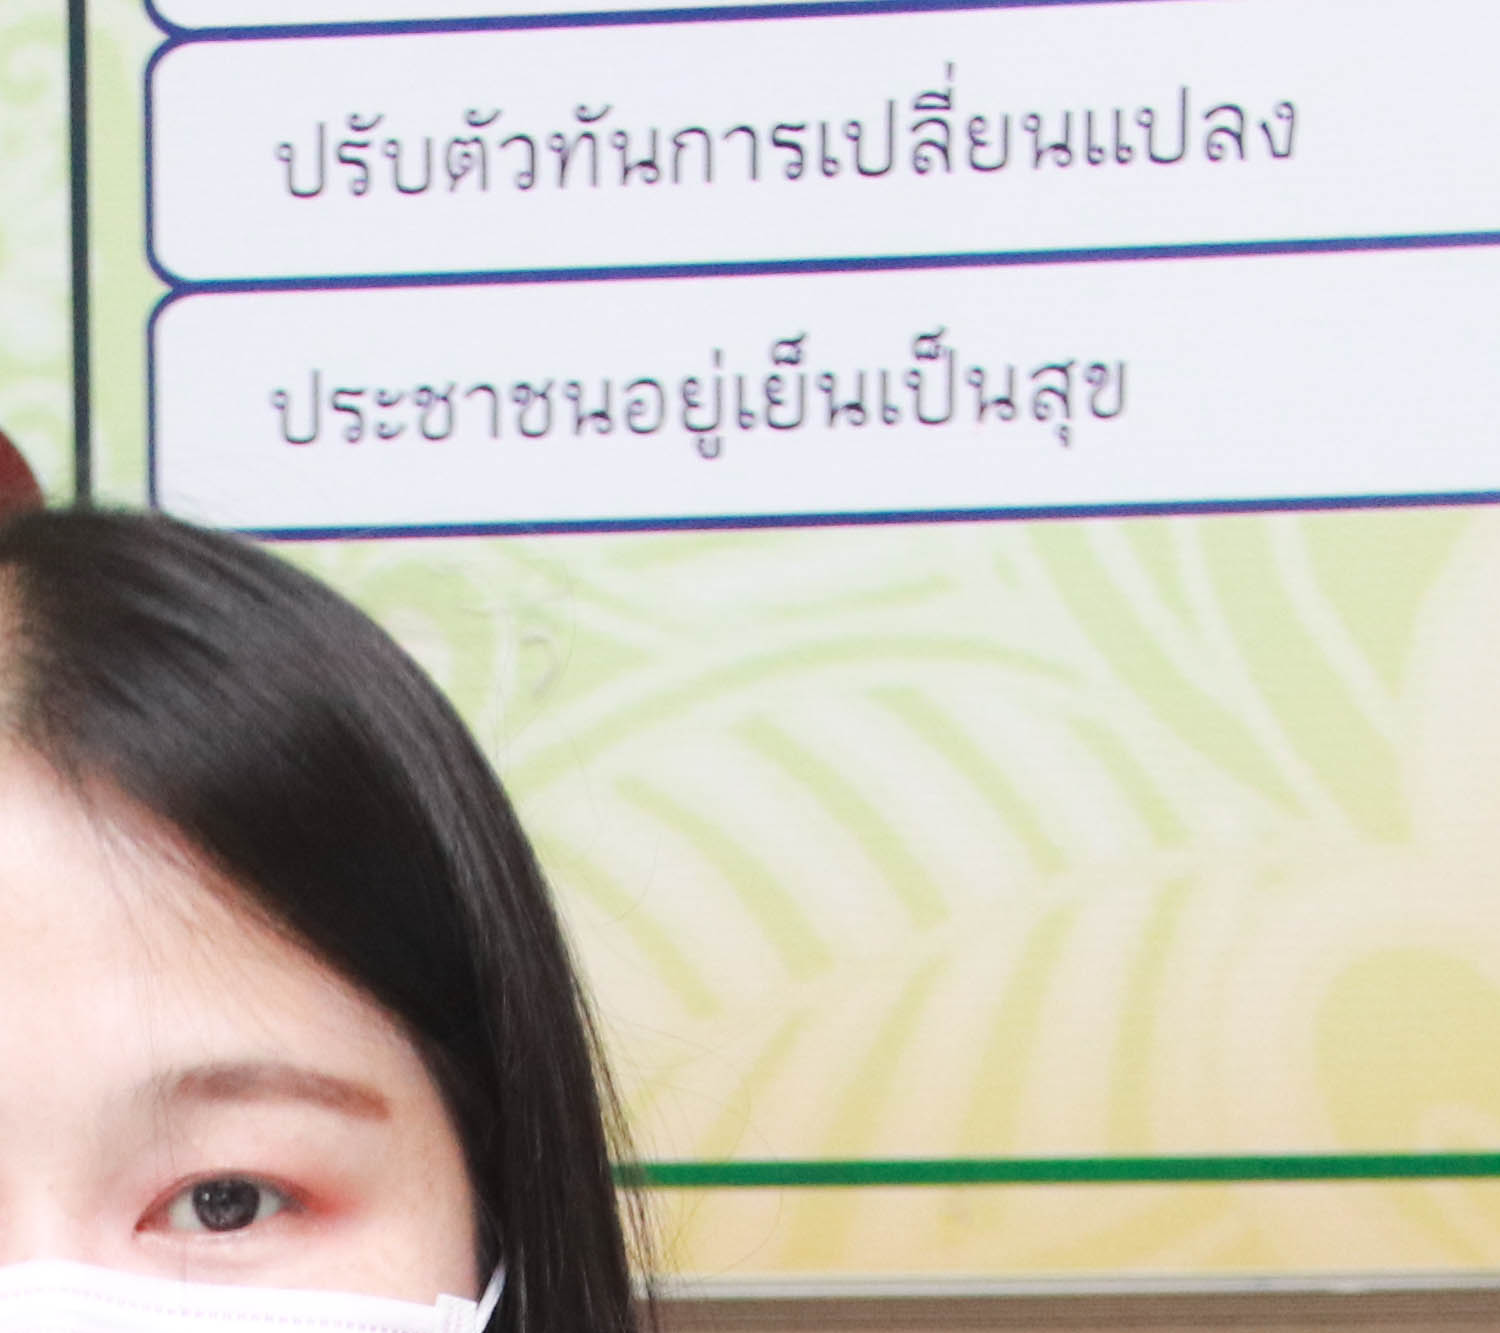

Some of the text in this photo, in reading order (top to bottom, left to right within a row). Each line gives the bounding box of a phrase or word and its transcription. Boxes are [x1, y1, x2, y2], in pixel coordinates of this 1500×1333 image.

[275, 60, 1300, 199] ปรับตัวทันการเปลี่ยนแปลง
[269, 325, 1128, 461] ประชาชนอยู่เย็นเป็นสุข
